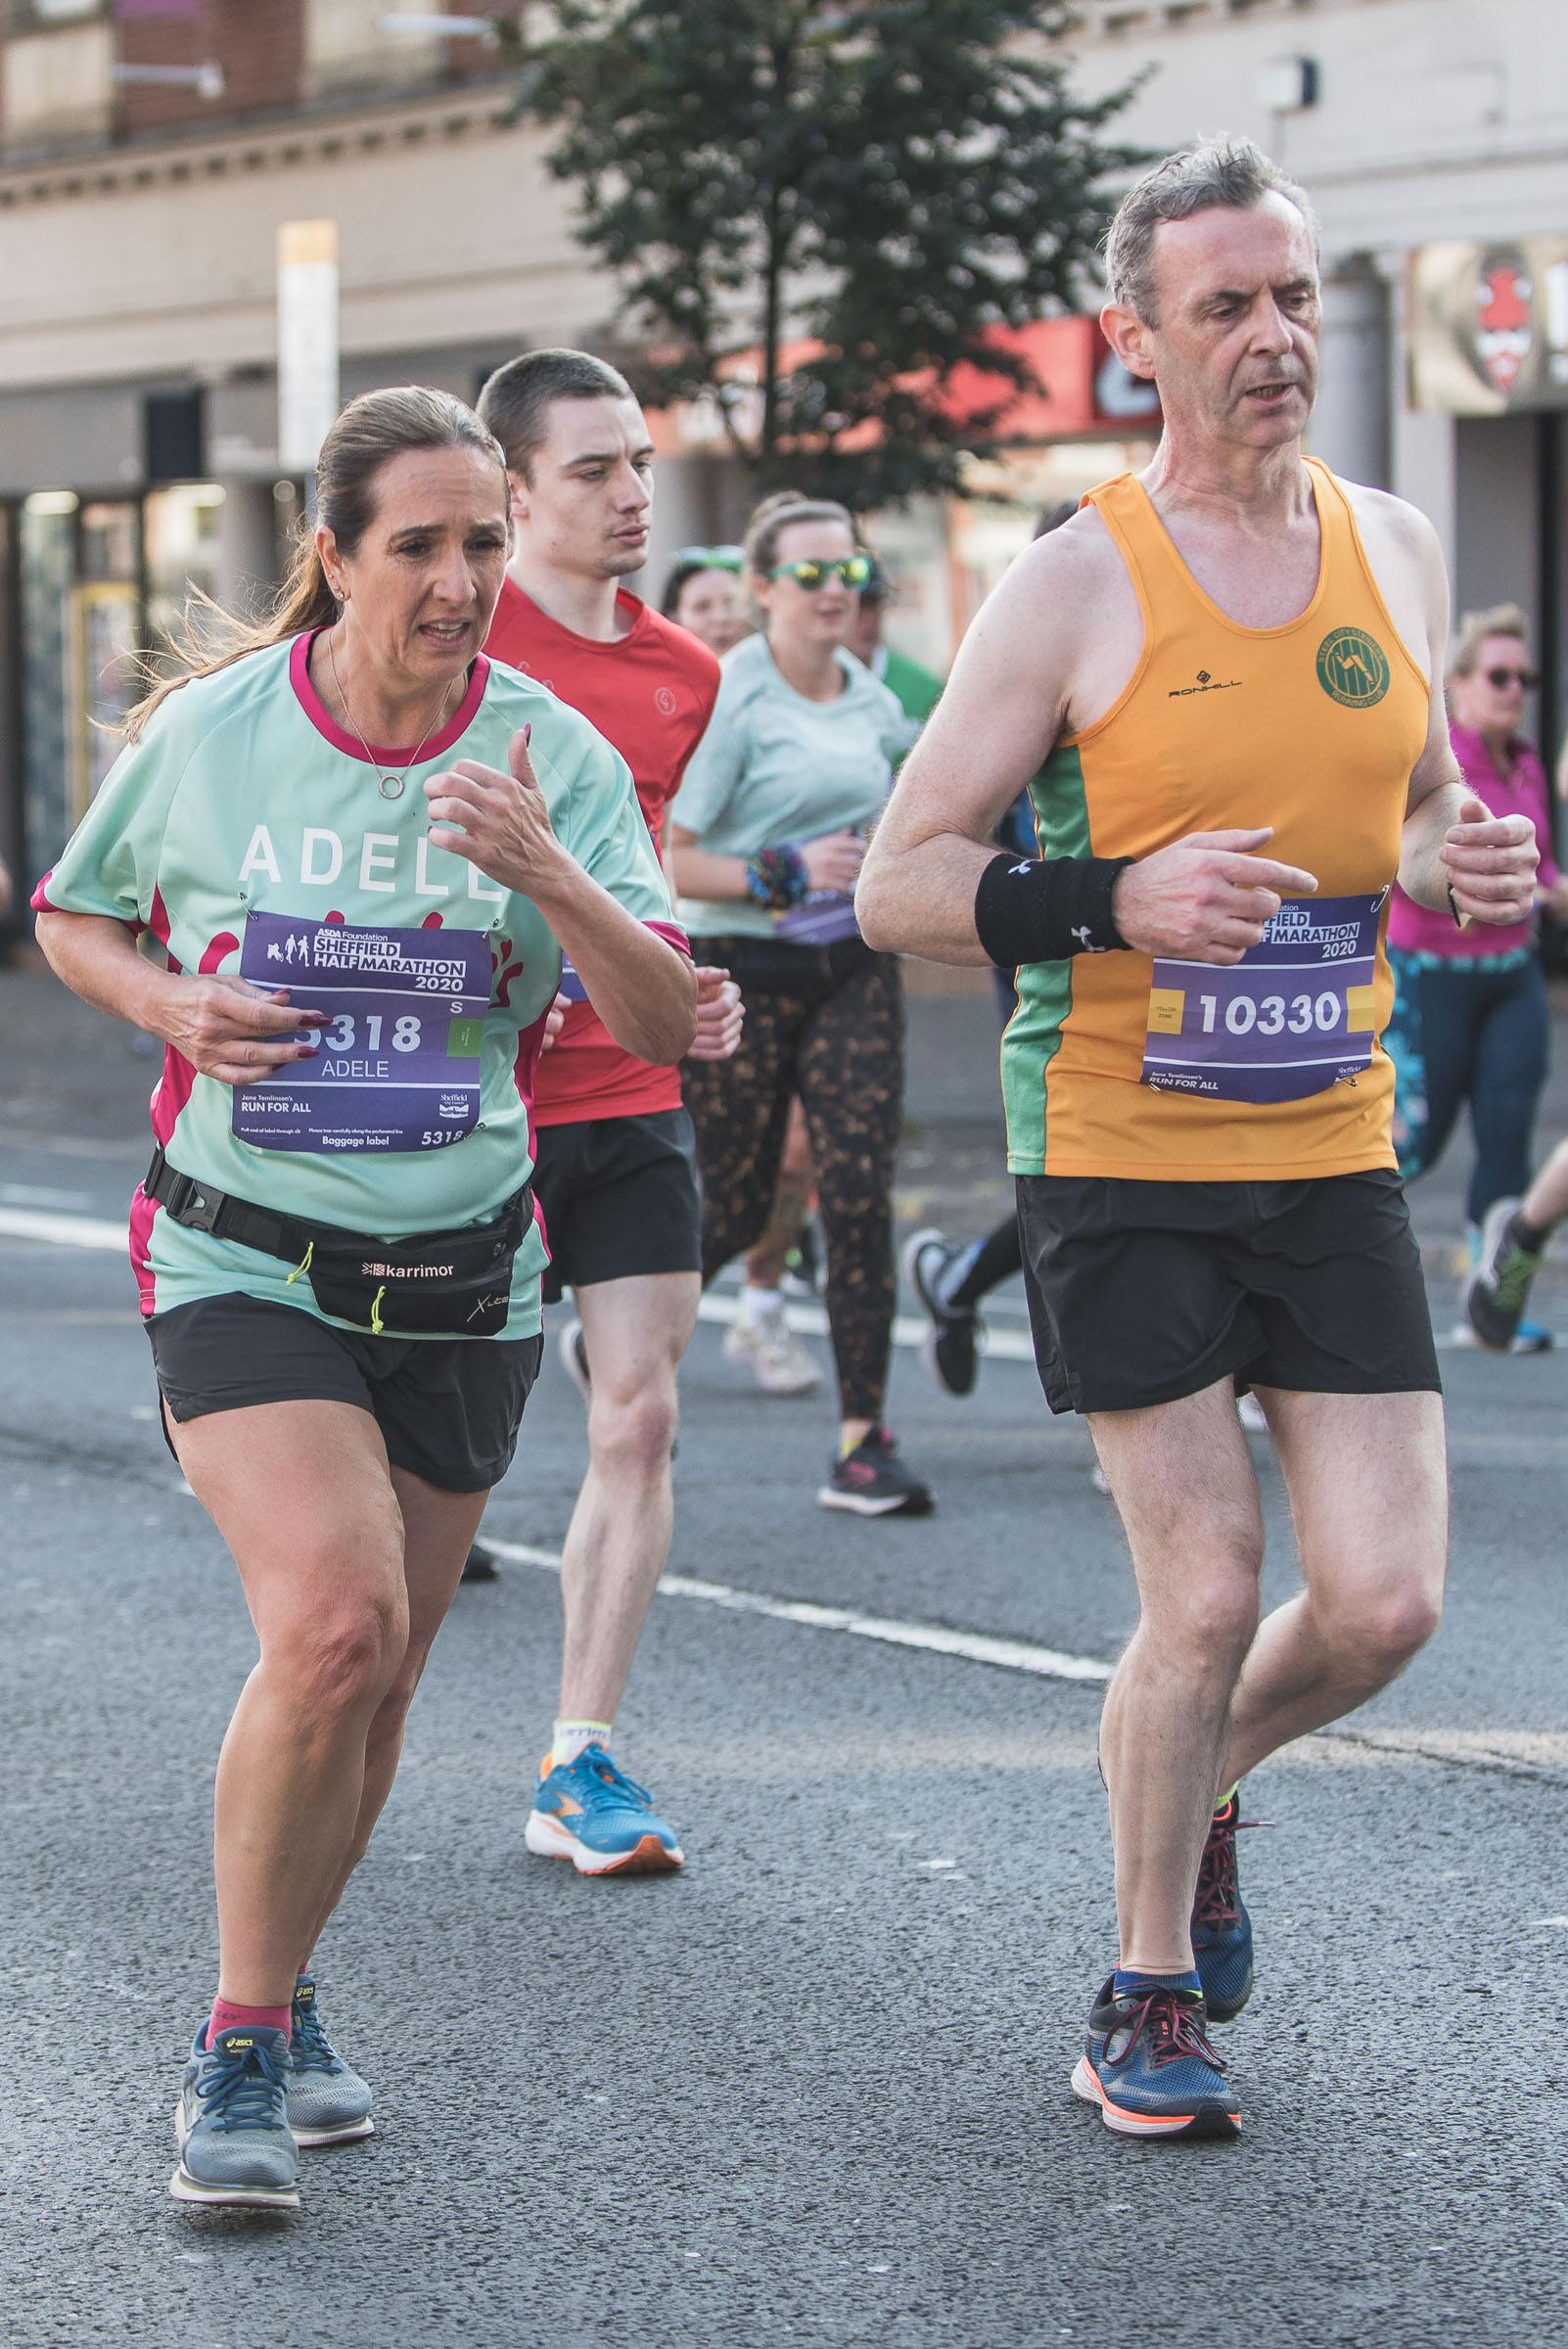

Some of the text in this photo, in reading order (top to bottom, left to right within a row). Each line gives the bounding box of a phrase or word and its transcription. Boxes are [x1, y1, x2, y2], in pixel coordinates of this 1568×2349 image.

[317, 928, 389, 942] ASDA Foundation
[1273, 923, 1359, 943] MARATHON
[316, 938, 398, 957] SHEFFIELD
[1321, 940, 1357, 958] 2020
[314, 953, 464, 977] HALF MARATHON
[415, 976, 464, 992] 2020
[450, 1001, 463, 1014] S
[1200, 991, 1341, 1035] 10330
[321, 1060, 390, 1078] ADELE
[1149, 1077, 1219, 1090] RUN FOR ALL
[241, 1102, 311, 1113] RUN FOR ALL
[322, 1135, 390, 1147] Baggage label
[421, 1130, 464, 1145] 5318
[387, 1265, 453, 1277] karrimor
